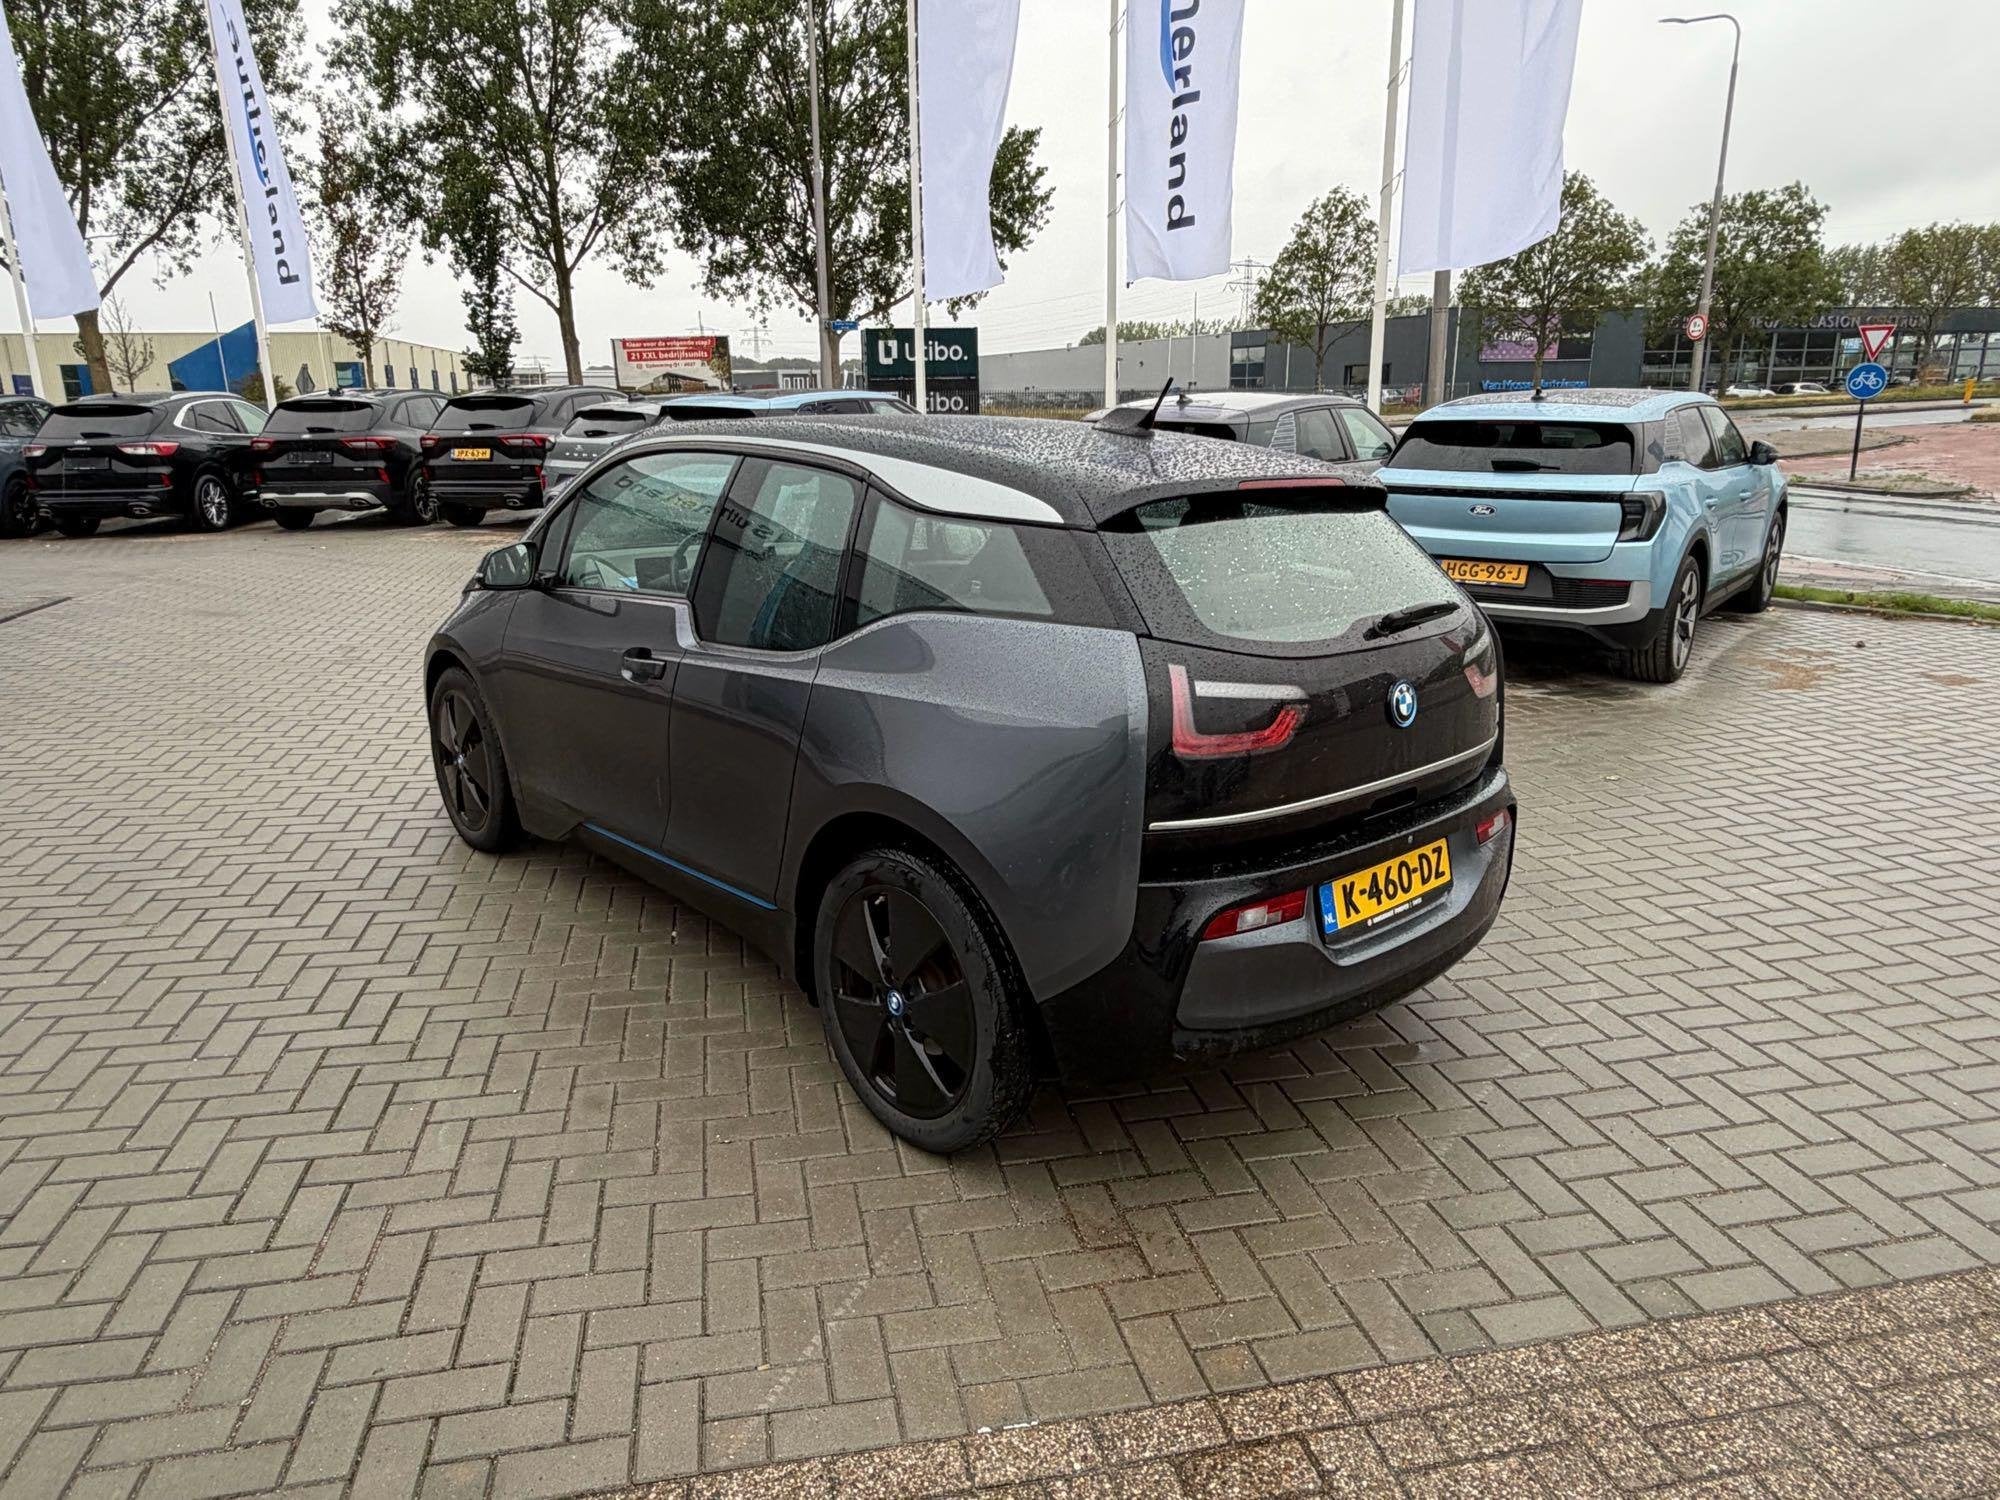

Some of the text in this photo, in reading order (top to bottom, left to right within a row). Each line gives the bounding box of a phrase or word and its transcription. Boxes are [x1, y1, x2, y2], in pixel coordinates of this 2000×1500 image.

[225, 16, 300, 285] Sutherland
[630, 352, 641, 360] 21
[642, 352, 658, 360] XXL
[906, 391, 969, 411] ibo.
[1446, 561, 1522, 581] HGG-96-J
[1341, 845, 1446, 919] K-460-DZ
